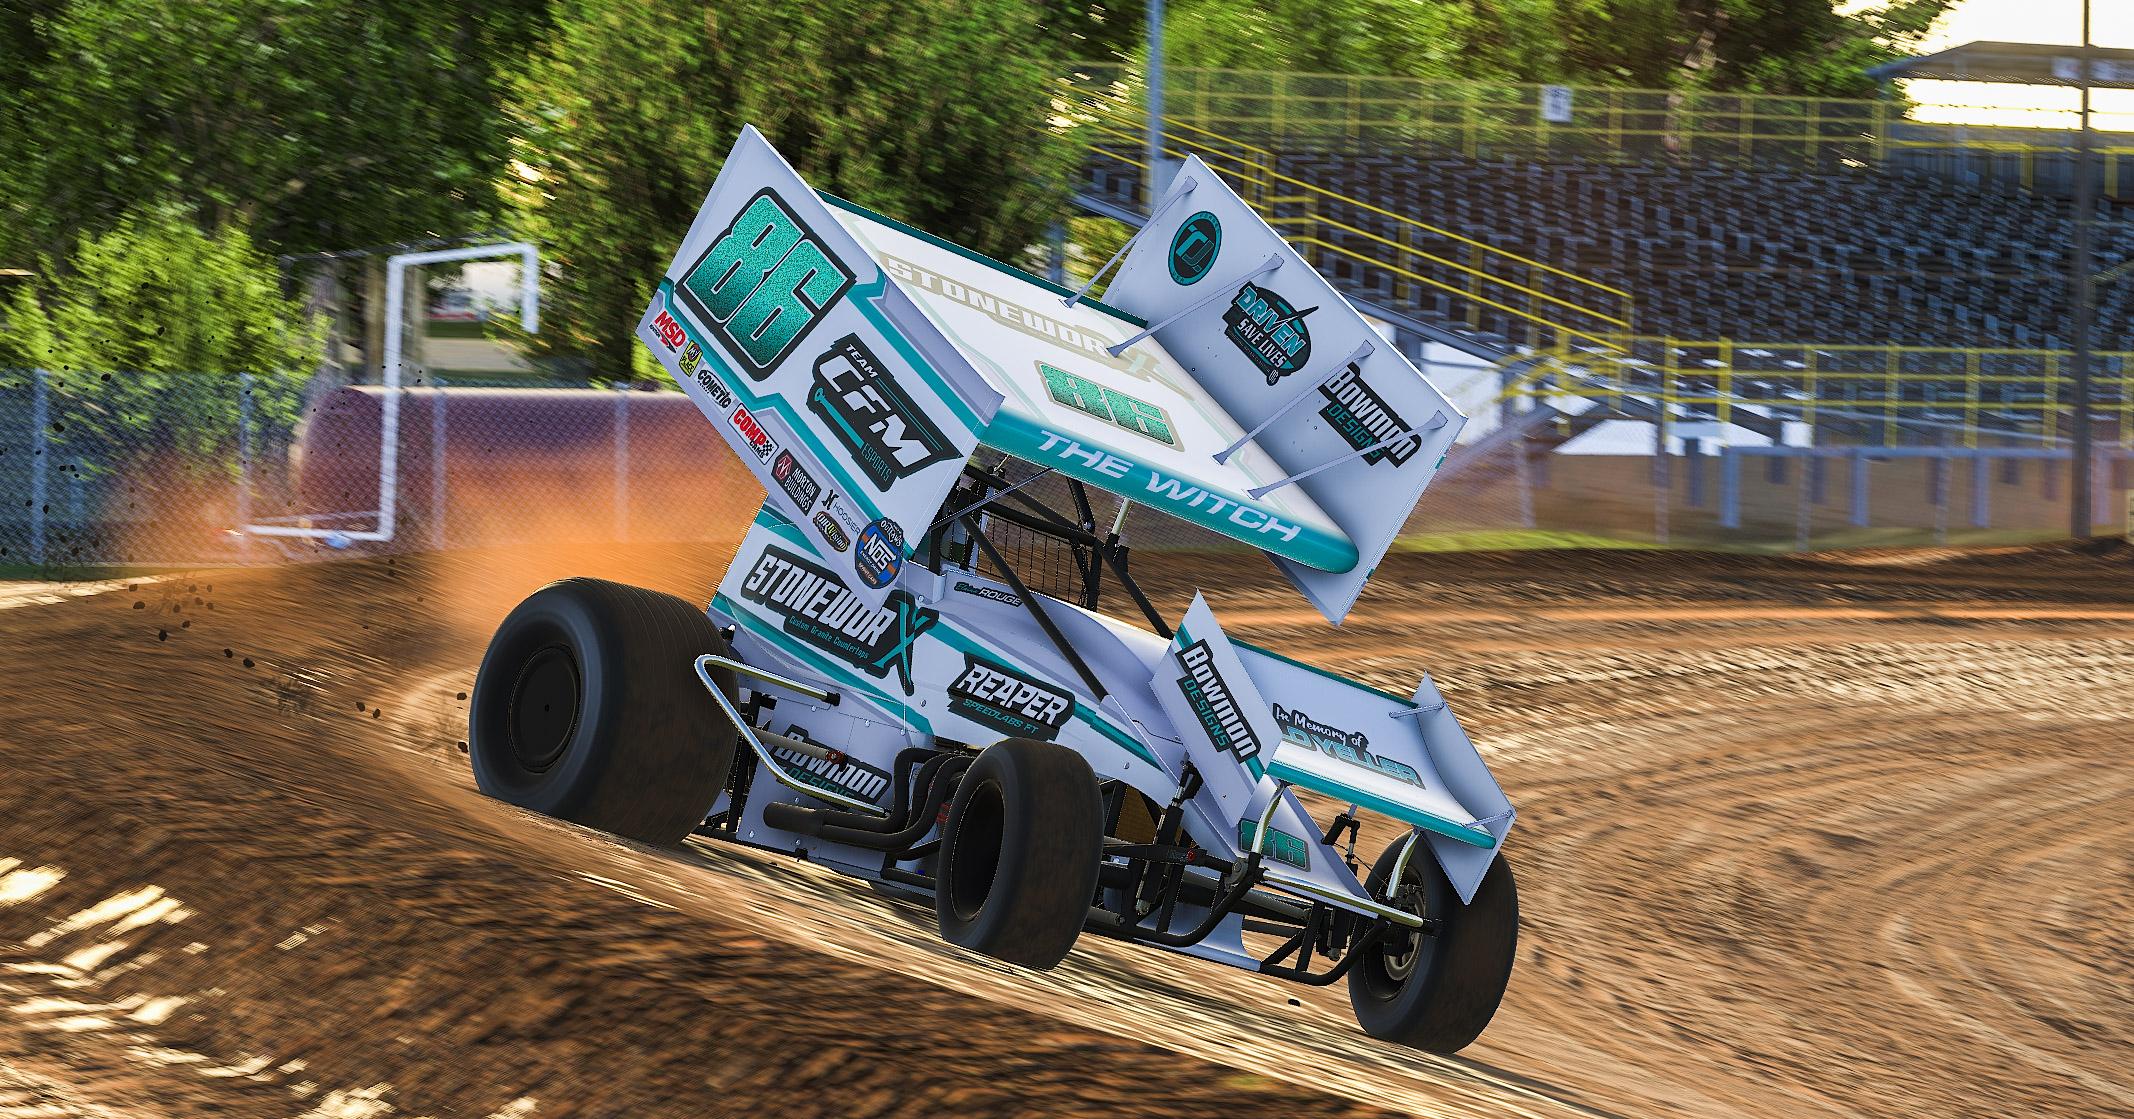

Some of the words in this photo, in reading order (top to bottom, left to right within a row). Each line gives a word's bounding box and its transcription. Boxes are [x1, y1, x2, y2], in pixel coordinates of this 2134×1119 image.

[681, 193, 849, 369] 86
[654, 310, 686, 347] MSD
[1236, 286, 1307, 358] DRIVEN
[846, 344, 878, 378] TEAM
[1237, 318, 1264, 345] SAVE
[1258, 339, 1287, 368] LIVES
[698, 369, 732, 409] COMETIC
[1039, 363, 1175, 446] 86
[733, 408, 767, 446] COMP
[819, 354, 932, 468] CFM
[749, 440, 765, 459] CAMS
[862, 442, 892, 482] ESPORTS
[784, 475, 812, 512] BUILDINGS
[792, 467, 817, 498] MORTON
[1038, 430, 1134, 479] THE
[1145, 471, 1302, 542] WITCH
[833, 502, 861, 535] HOOSIER
[864, 533, 897, 571] NOS
[979, 588, 1021, 606] ROUGE
[789, 614, 810, 631] Custom
[810, 625, 833, 642] Granite
[834, 636, 869, 660] Countertops
[956, 662, 1069, 725] REAPER
[1183, 679, 1231, 747] DESIGNS
[962, 699, 1024, 728] SPEEDLABS
[1023, 723, 1040, 734] FT
[1276, 706, 1290, 722] In
[1294, 713, 1346, 746] Memory
[1351, 736, 1362, 747] of
